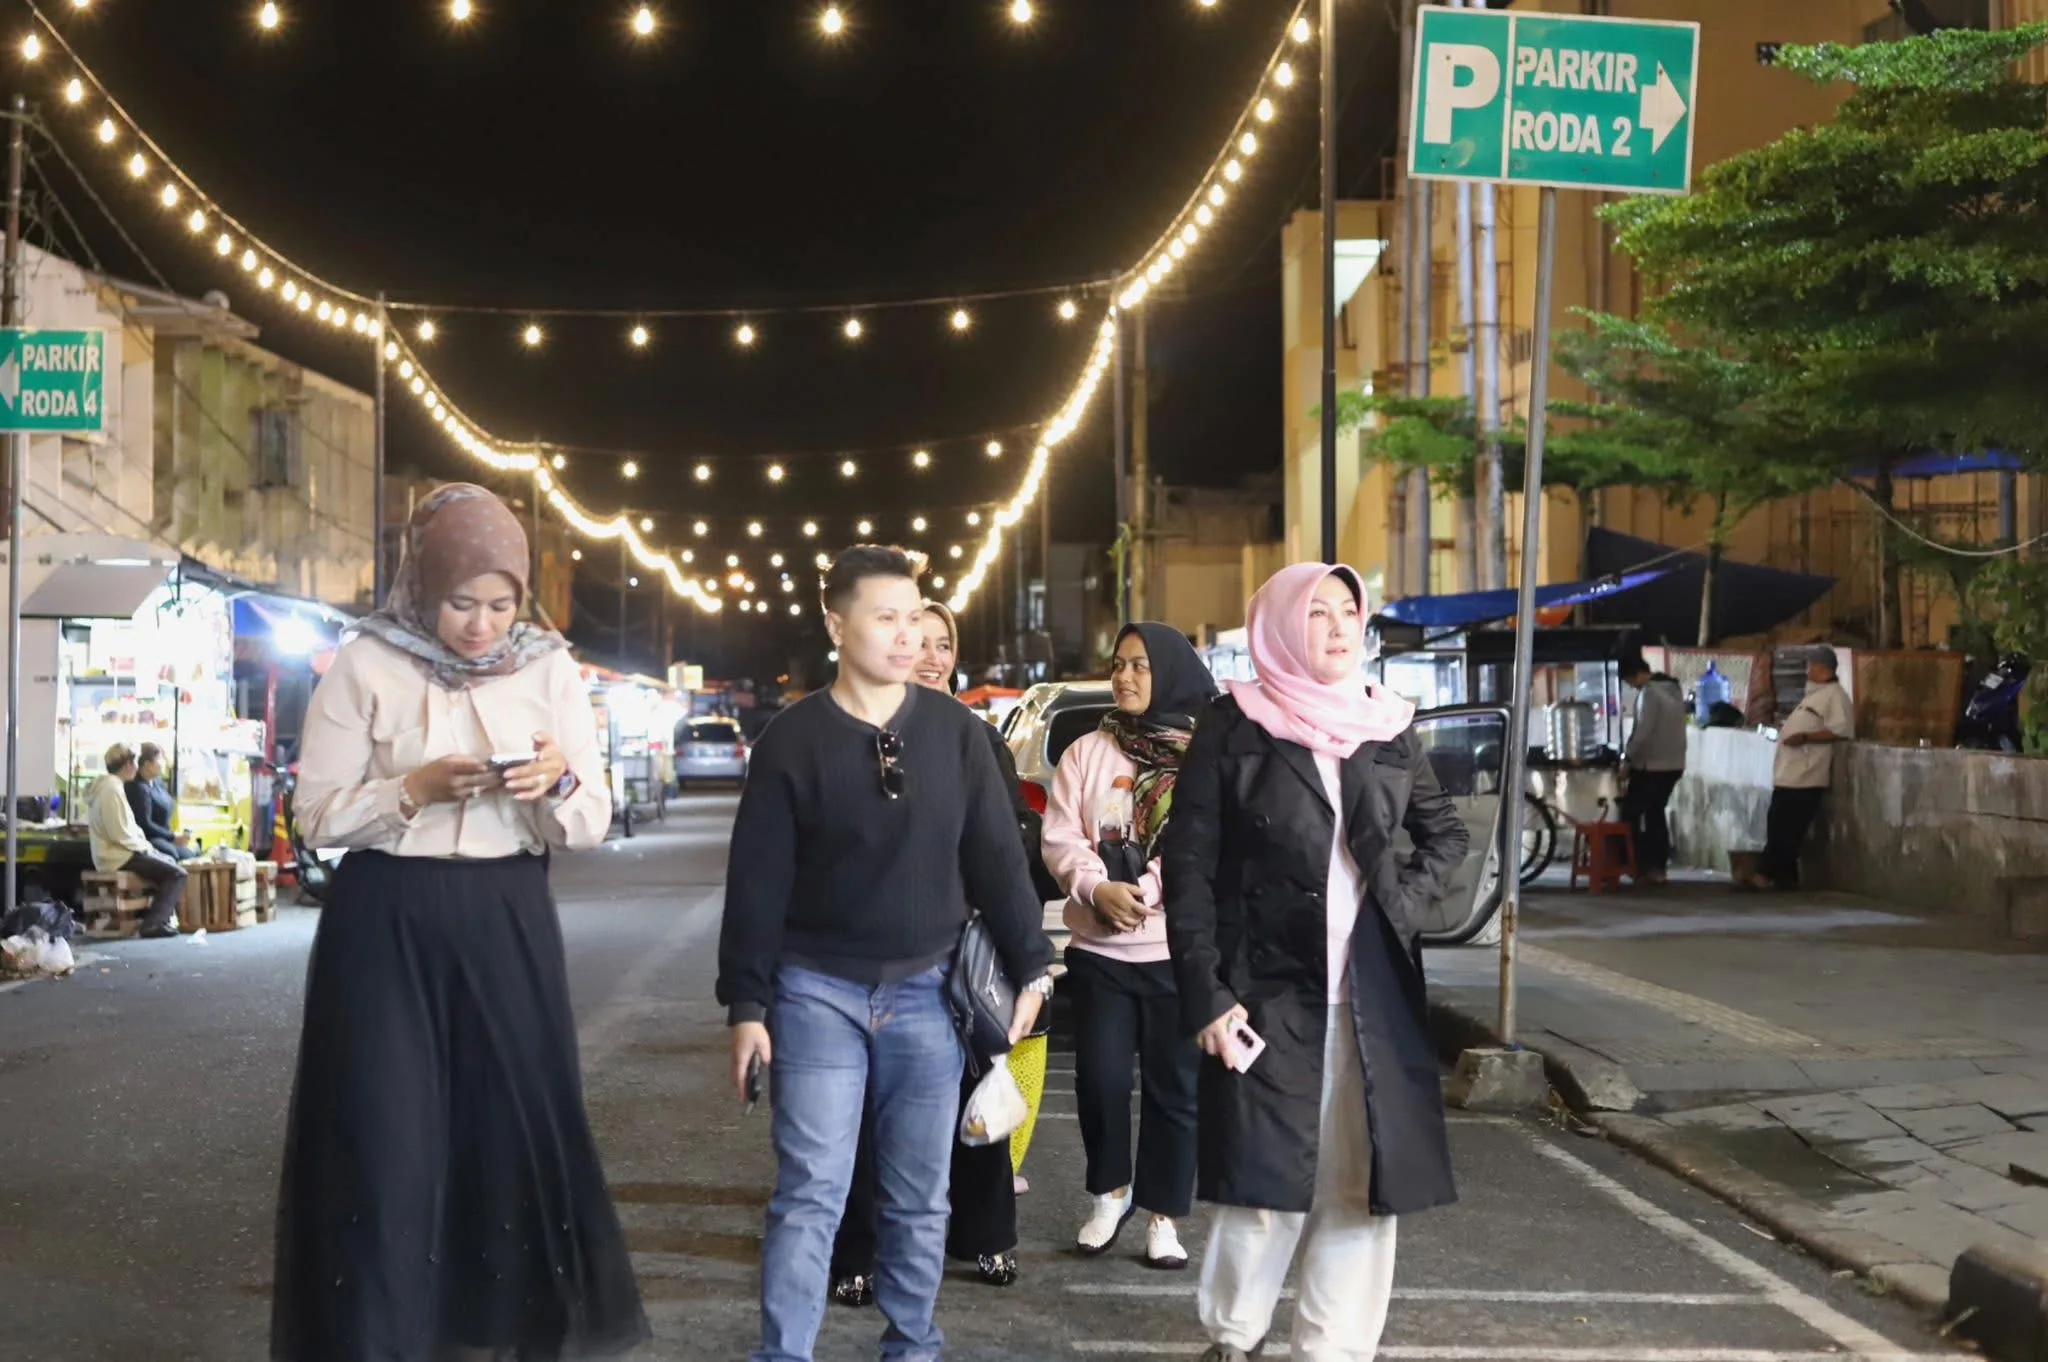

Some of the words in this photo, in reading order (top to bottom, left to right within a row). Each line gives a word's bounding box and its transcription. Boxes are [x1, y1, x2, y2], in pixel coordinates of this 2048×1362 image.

[1423, 42, 1500, 144] P
[1516, 47, 1638, 93] PARKIR
[1512, 110, 1602, 154] RODA
[1611, 116, 1631, 156] 2
[22, 344, 100, 372] PARKIR
[21, 389, 79, 417] RODA
[85, 390, 97, 417] 4
